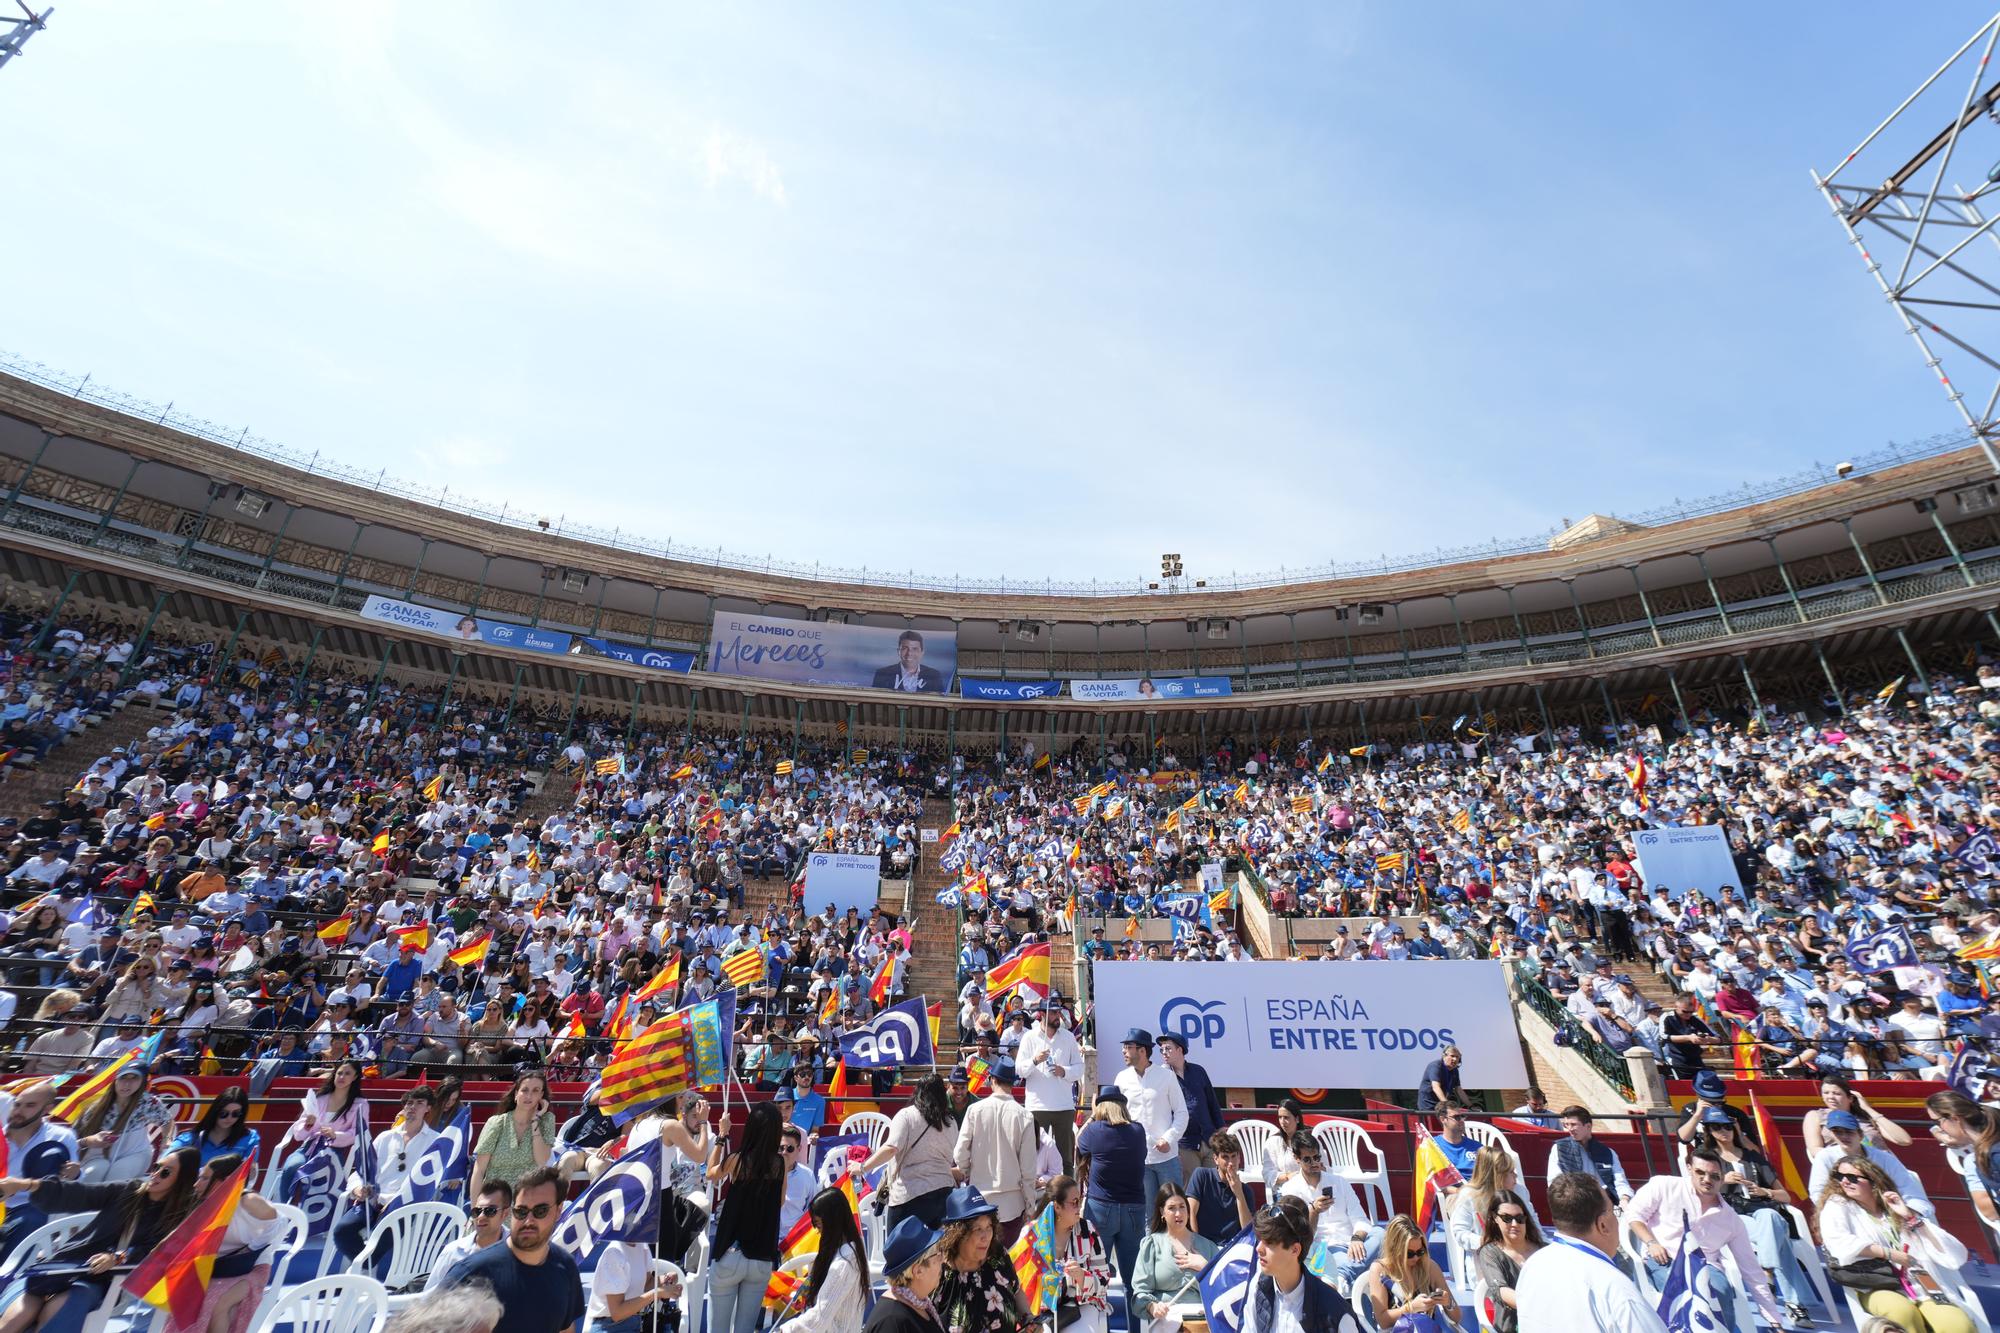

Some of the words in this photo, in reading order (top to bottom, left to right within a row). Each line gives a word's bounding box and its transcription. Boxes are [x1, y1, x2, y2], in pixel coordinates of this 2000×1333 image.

[394, 613, 439, 629] VOTAR!
[527, 632, 535, 640] LA
[730, 622, 745, 632] EL
[747, 624, 795, 637] CAMBIO
[797, 629, 822, 640] QUE
[713, 635, 829, 672] Mereces
[978, 687, 1011, 696] VOTA
[1266, 995, 1370, 1021] ESPAÑA
[1269, 1028, 1359, 1051] ENTRE
[1361, 1028, 1457, 1050] TODOS
